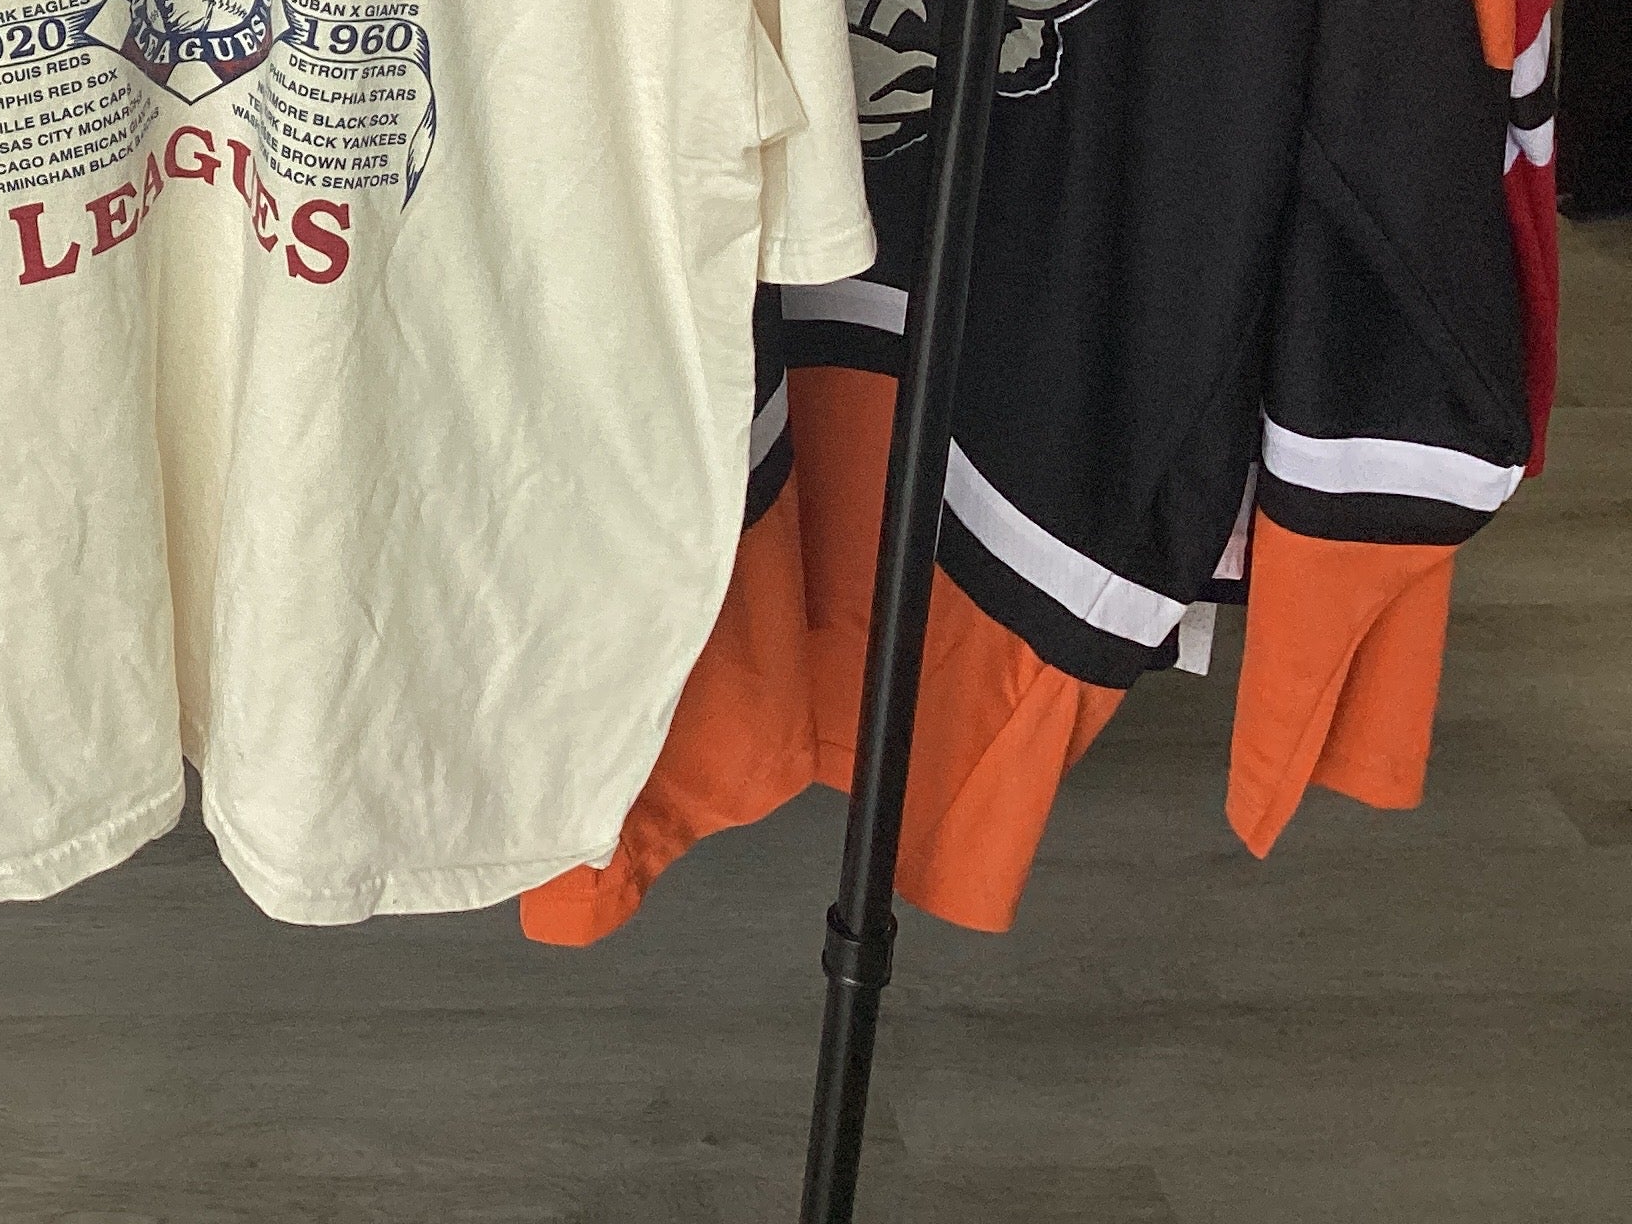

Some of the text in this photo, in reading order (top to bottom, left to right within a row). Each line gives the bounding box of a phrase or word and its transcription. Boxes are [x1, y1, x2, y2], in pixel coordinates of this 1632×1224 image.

[349, 4, 360, 18] X
[364, 3, 419, 17] GIANTS
[133, 14, 268, 64] LEAGUES
[303, 17, 413, 56] 1960
[46, 53, 91, 75] REDS
[289, 54, 407, 80] DETROIT STARS
[48, 79, 82, 100] RED
[87, 67, 119, 88] SOX
[269, 62, 417, 105] PHILADELPHIA STARS
[40, 99, 96, 126] BLACK
[99, 83, 132, 109] CAPS
[282, 123, 338, 149] BLACK
[342, 132, 407, 150] YANKEES
[312, 116, 367, 130] BLACK
[369, 113, 400, 126] SOX
[38, 127, 73, 147] CITY
[48, 129, 128, 167] AMERICAN
[89, 145, 134, 173] BLACK
[269, 157, 318, 187] BLACK
[321, 173, 400, 190] SENATORS
[280, 146, 347, 171] BROWN
[351, 154, 388, 170] RATS
[8, 126, 351, 286] LEAGUES
